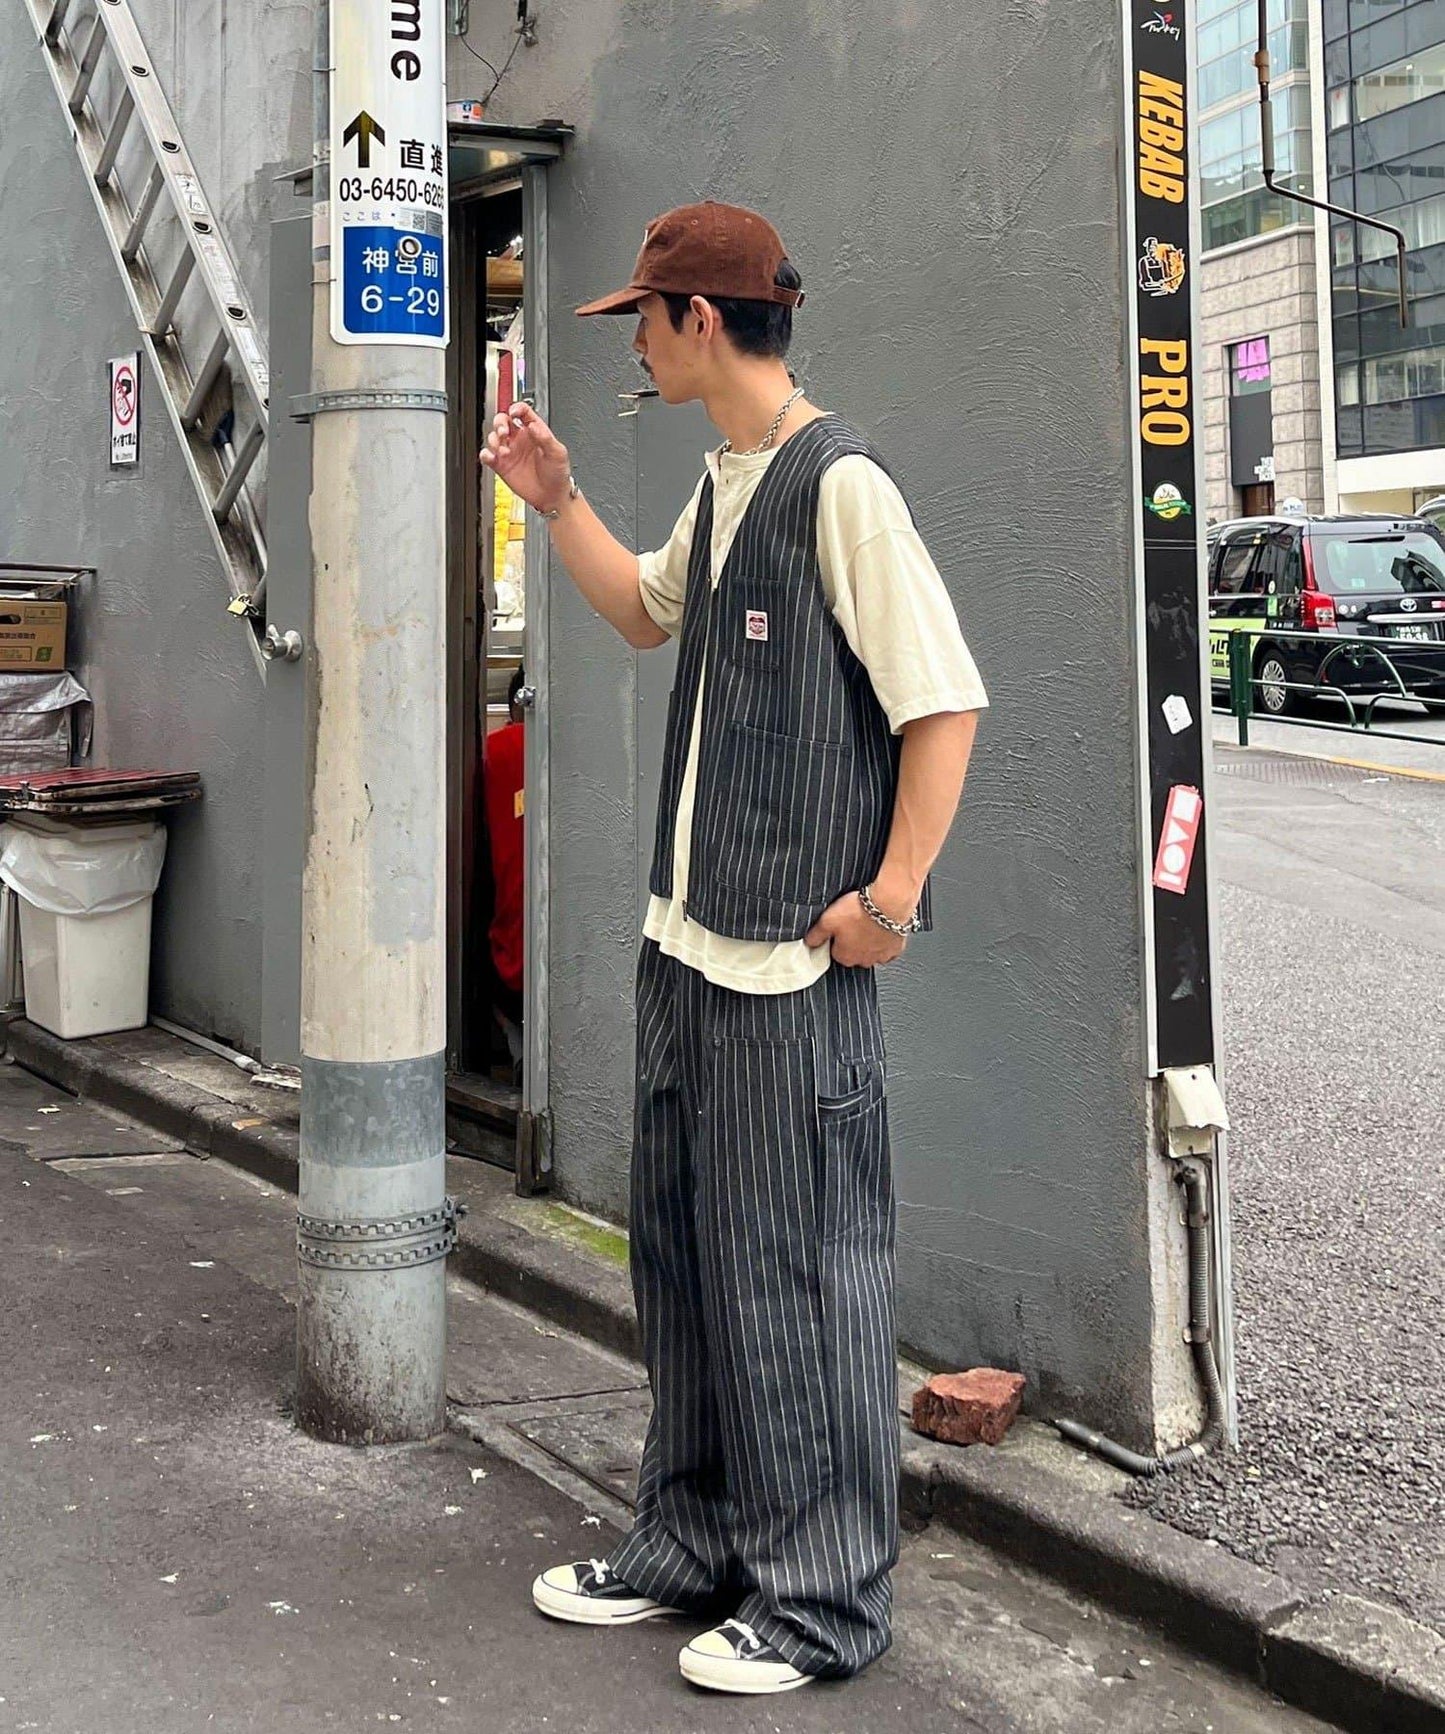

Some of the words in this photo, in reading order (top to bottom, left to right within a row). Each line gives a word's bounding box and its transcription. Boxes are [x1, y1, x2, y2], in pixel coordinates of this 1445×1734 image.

[1139, 70, 1185, 205] KEBAB
[361, 285, 440, 317] 6-29
[1140, 337, 1191, 446] PRO
